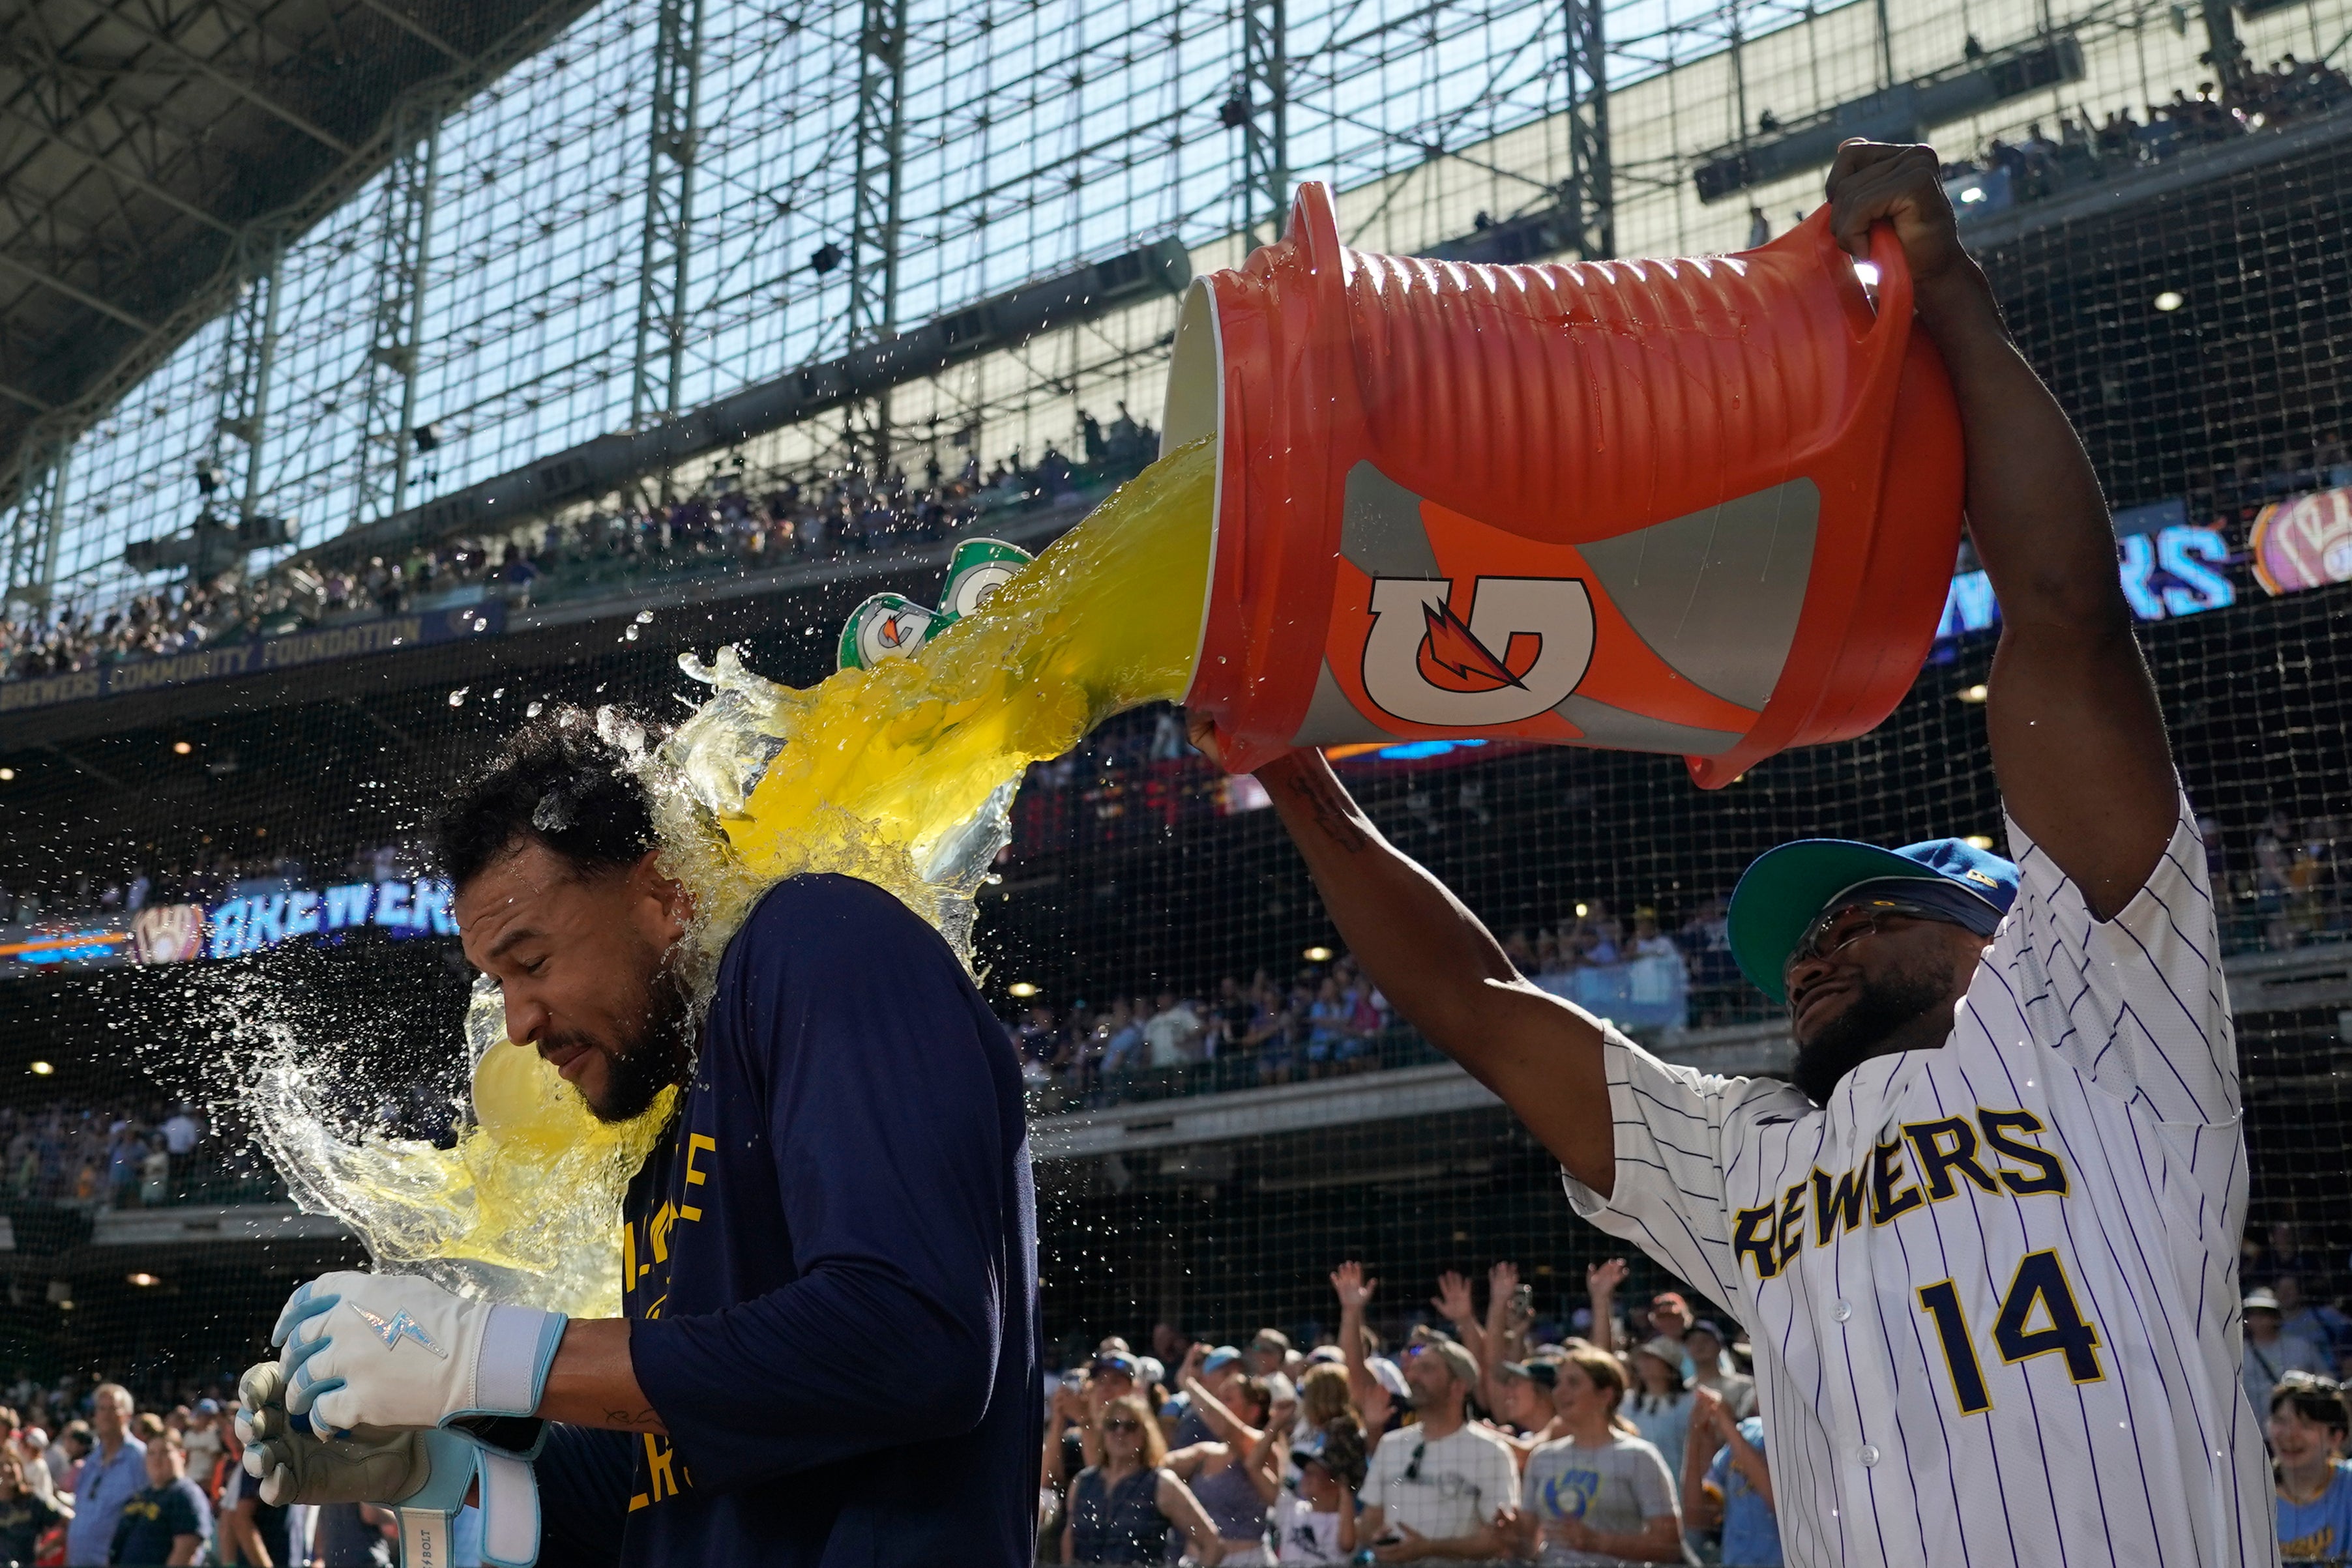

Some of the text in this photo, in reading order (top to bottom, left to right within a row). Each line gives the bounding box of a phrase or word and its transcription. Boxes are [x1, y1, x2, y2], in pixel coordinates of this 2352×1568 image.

[0, 617, 422, 710] BREWERS COMMUNITY FOUNDATION
[211, 877, 460, 958] BREWER
[1733, 1105, 2071, 1279] REWERS
[1915, 1247, 2107, 1417] 14
[420, 1530, 432, 1558] BOLT
